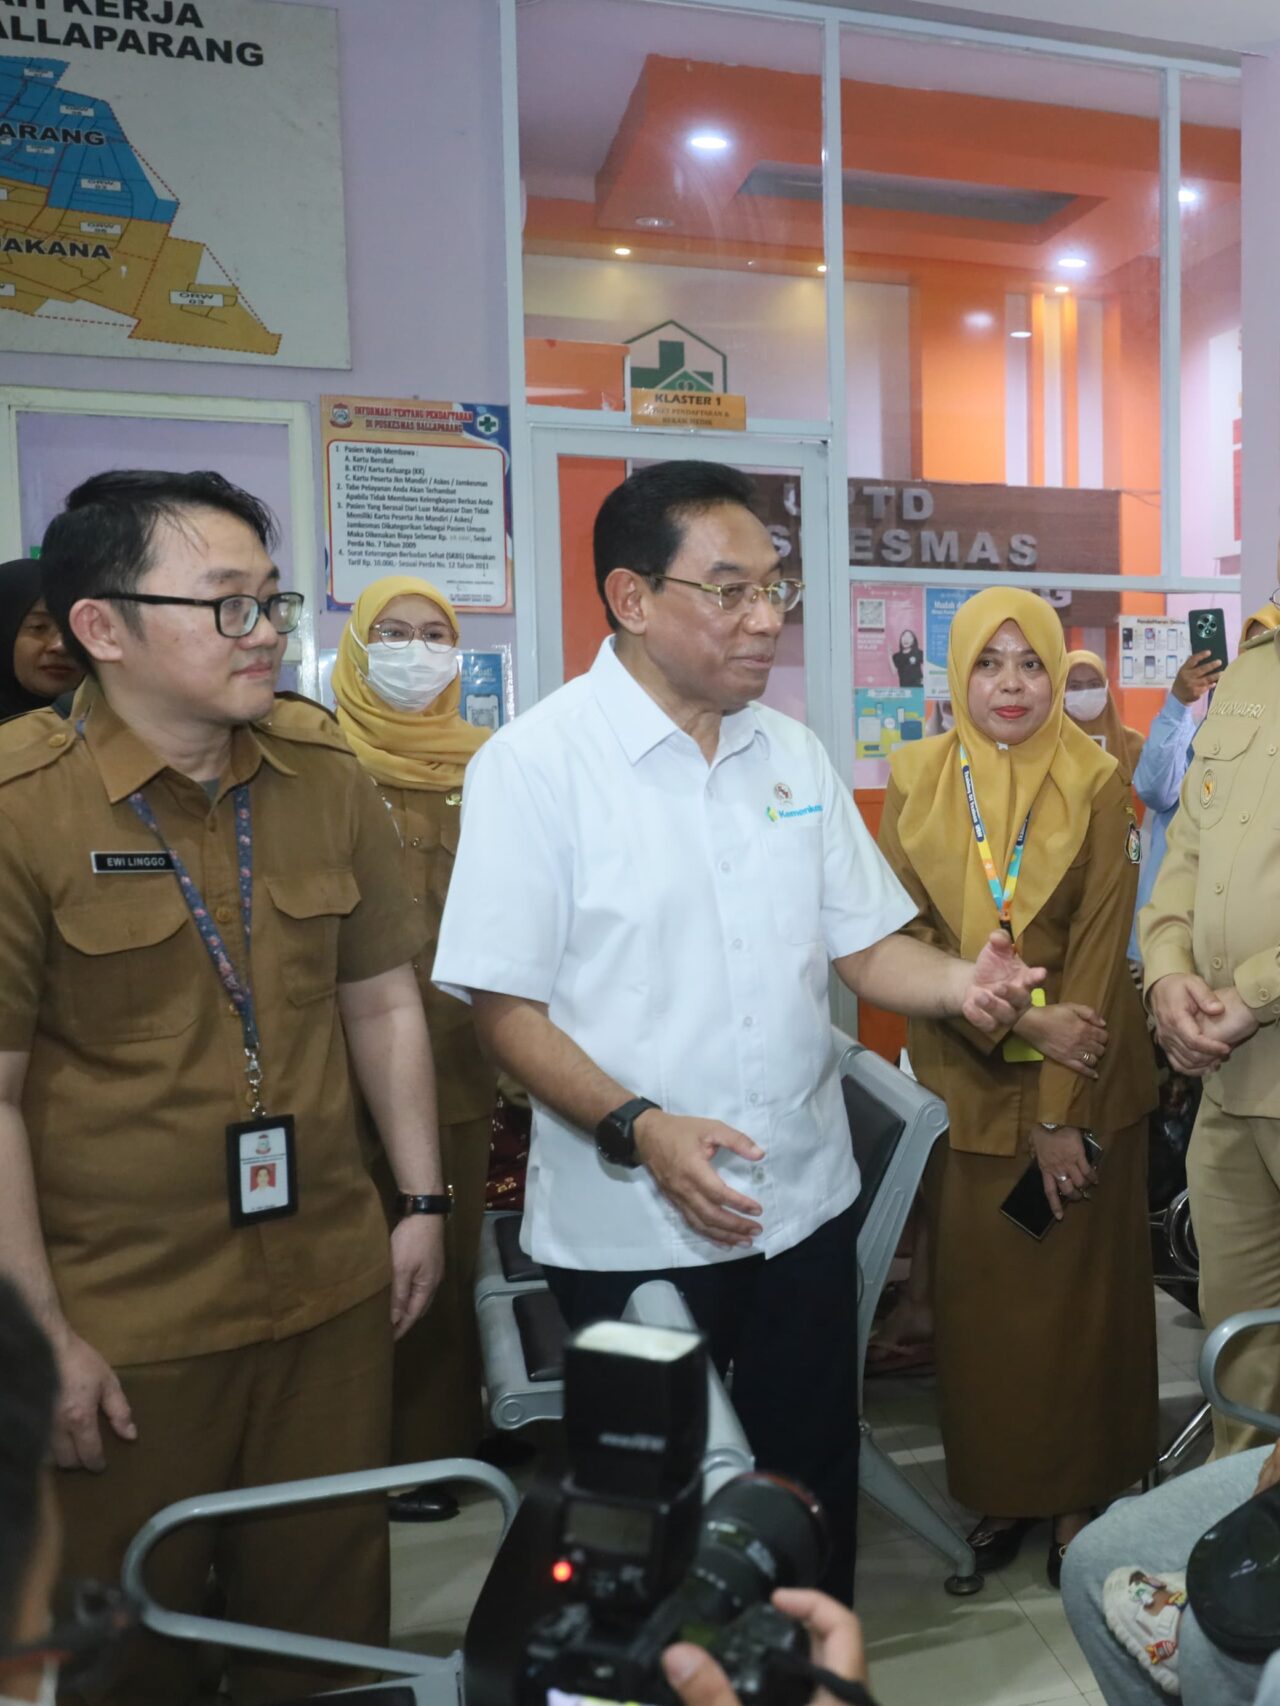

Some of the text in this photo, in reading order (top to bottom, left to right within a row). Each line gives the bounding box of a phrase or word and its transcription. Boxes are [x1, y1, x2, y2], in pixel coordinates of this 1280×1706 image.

[63, 0, 204, 28] KERJA
[179, 292, 214, 300] ORW
[655, 394, 721, 406] KLASTER 1
[768, 525, 1038, 566] SESMAS
[127, 857, 166, 866] LINGGO
